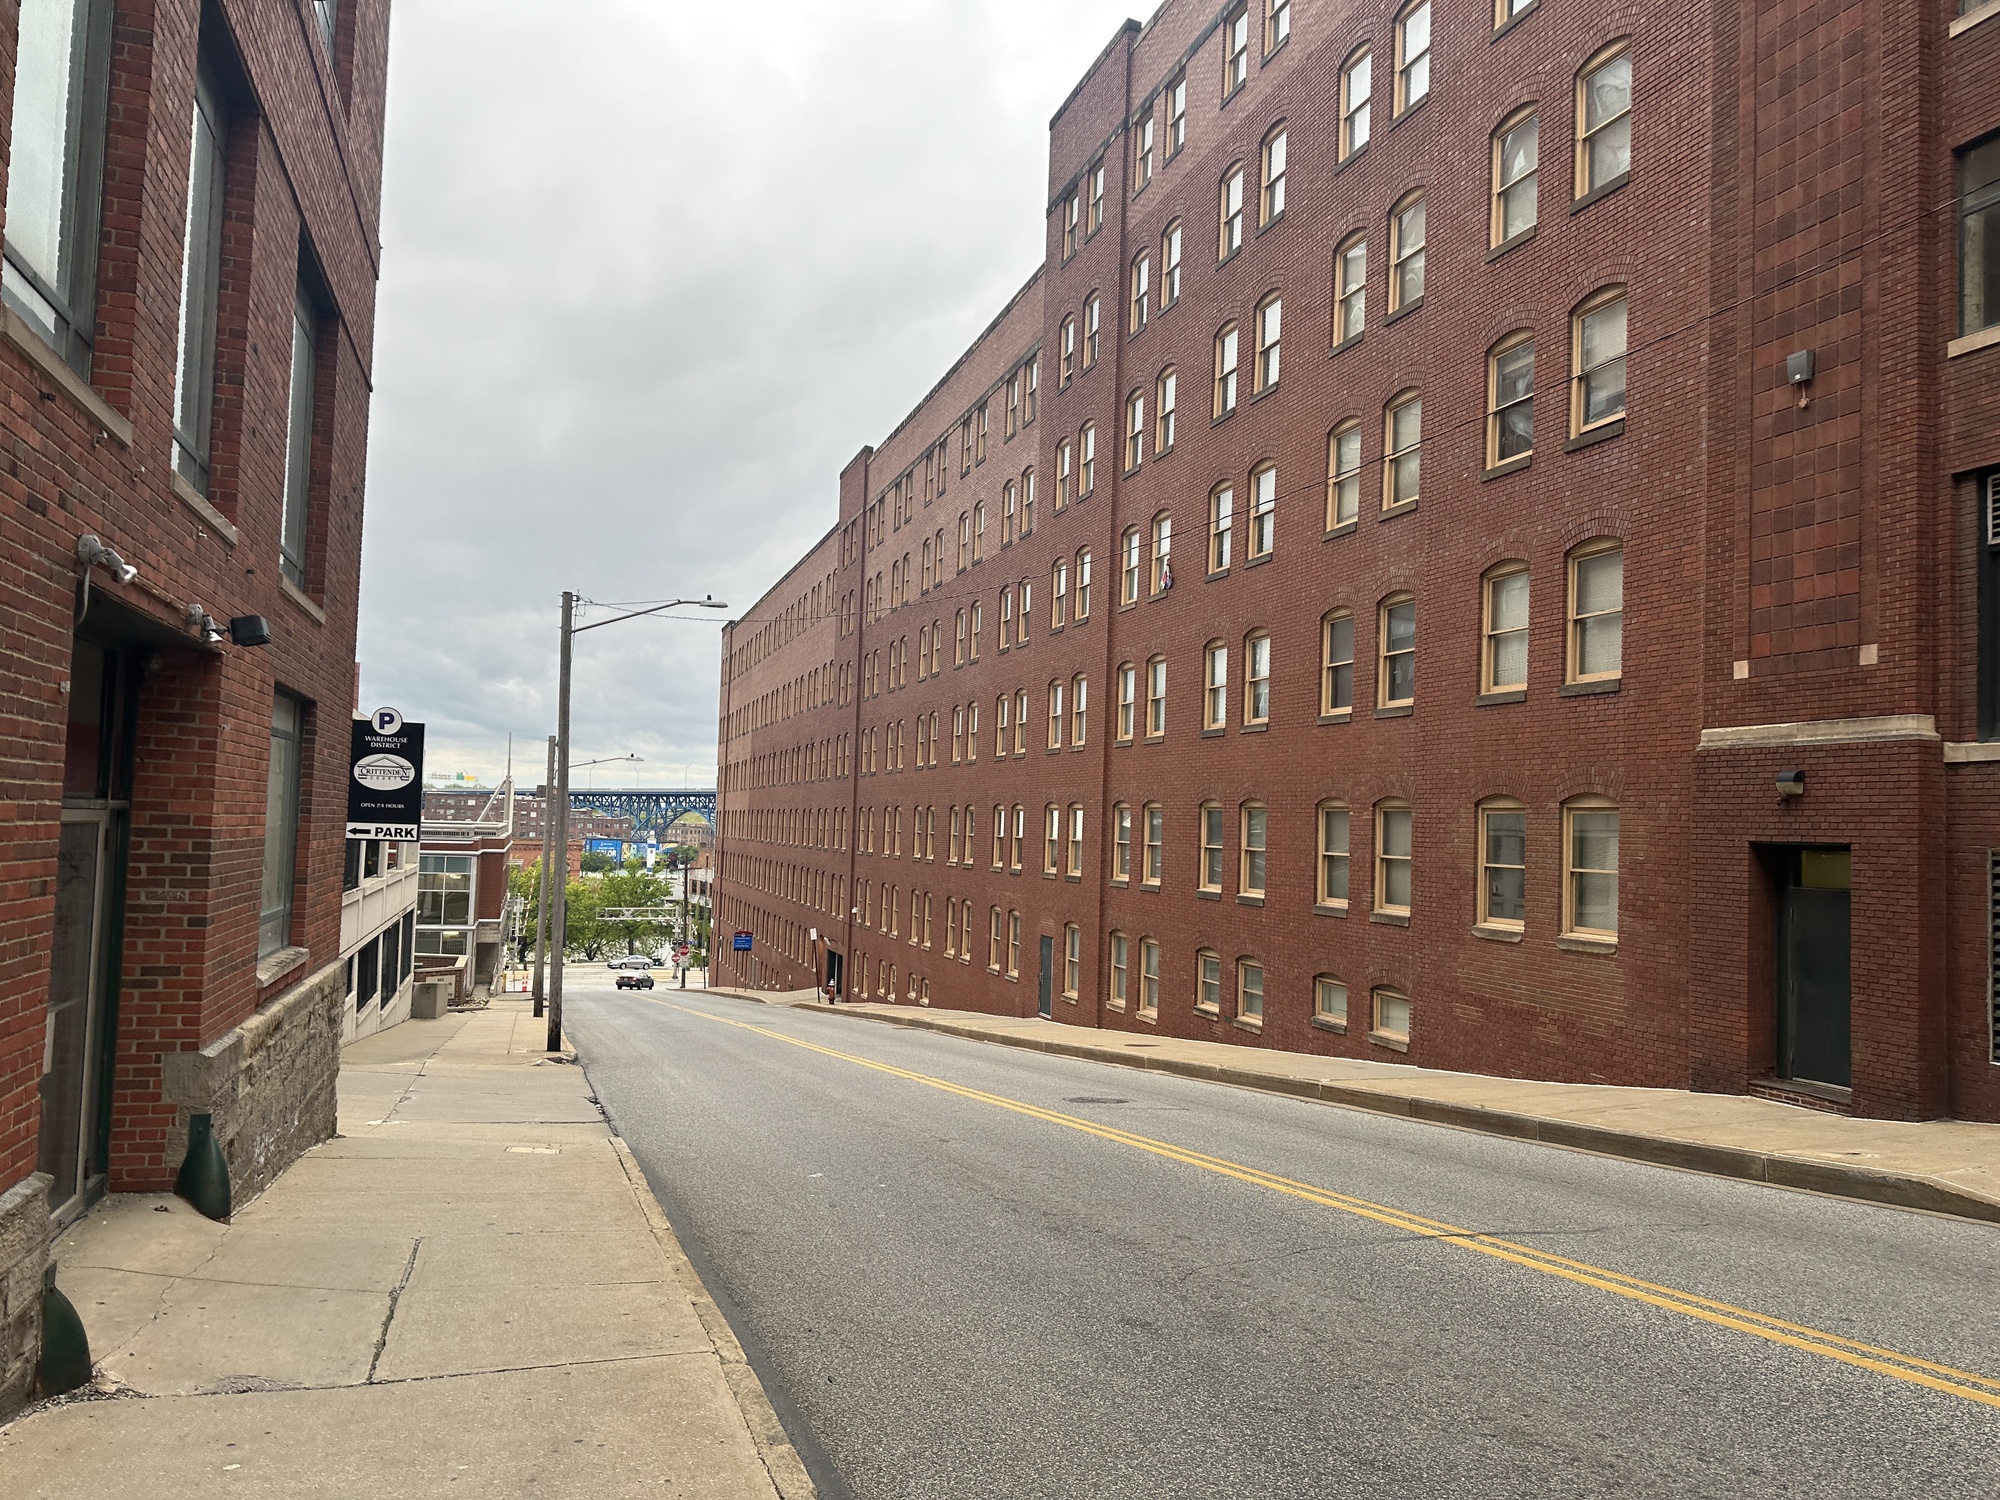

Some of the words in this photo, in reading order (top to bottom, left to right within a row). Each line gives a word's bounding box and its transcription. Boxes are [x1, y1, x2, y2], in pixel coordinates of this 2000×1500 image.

[378, 712, 395, 730] P
[365, 735, 408, 744] WAREHOUSE
[360, 767, 408, 777] CRITTENDEN
[375, 827, 415, 839] PARK
